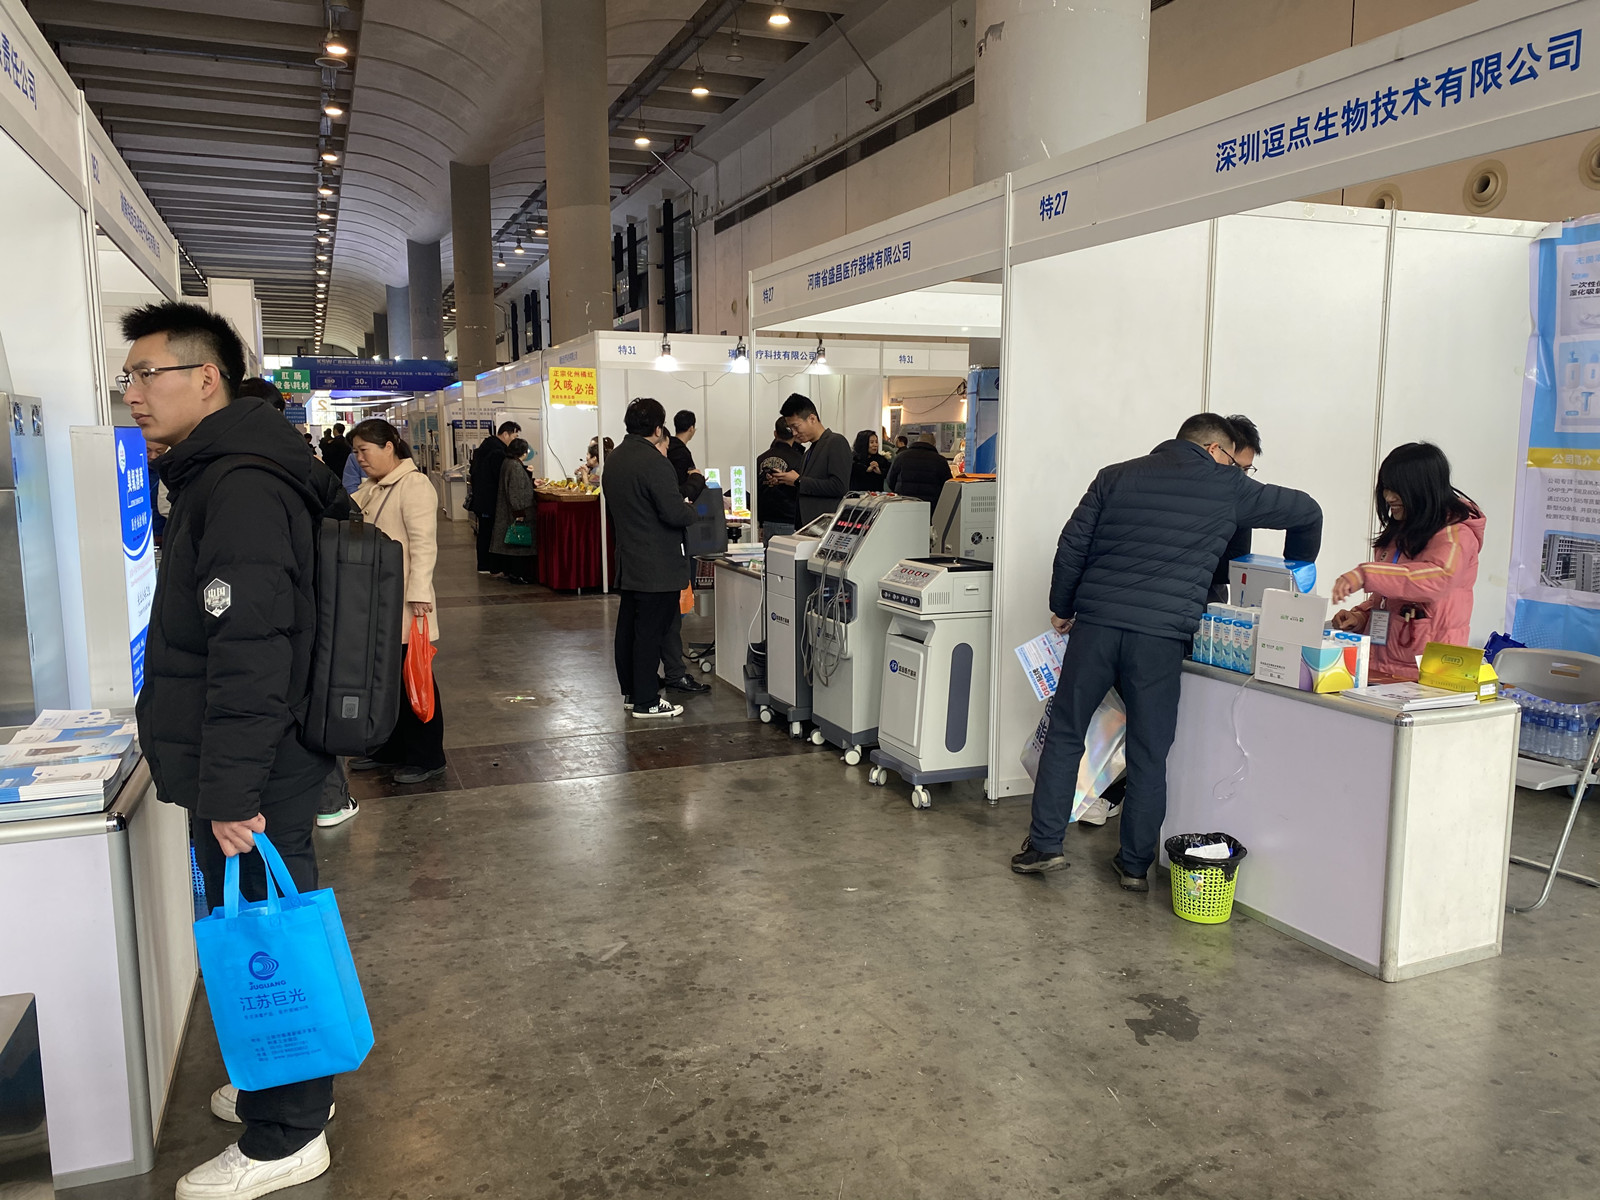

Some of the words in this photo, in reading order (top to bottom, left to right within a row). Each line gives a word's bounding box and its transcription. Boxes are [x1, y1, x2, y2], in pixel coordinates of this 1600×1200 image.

[0, 32, 37, 111] 责任公司
[1215, 28, 1583, 174] 深圳逗点生物技术有限公司
[1039, 190, 1069, 223] 特27
[807, 241, 911, 291] 河南省盛昌医疗器械有限公司
[763, 287, 774, 304] 特27
[618, 345, 636, 355] 特31
[728, 349, 818, 361] 瑞疗科技有限公司
[899, 355, 913, 364] 特31
[553, 370, 593, 378] 正宗化州橘红
[553, 379, 594, 395] 久咳必治
[239, 988, 307, 1011] 江苏巨光
